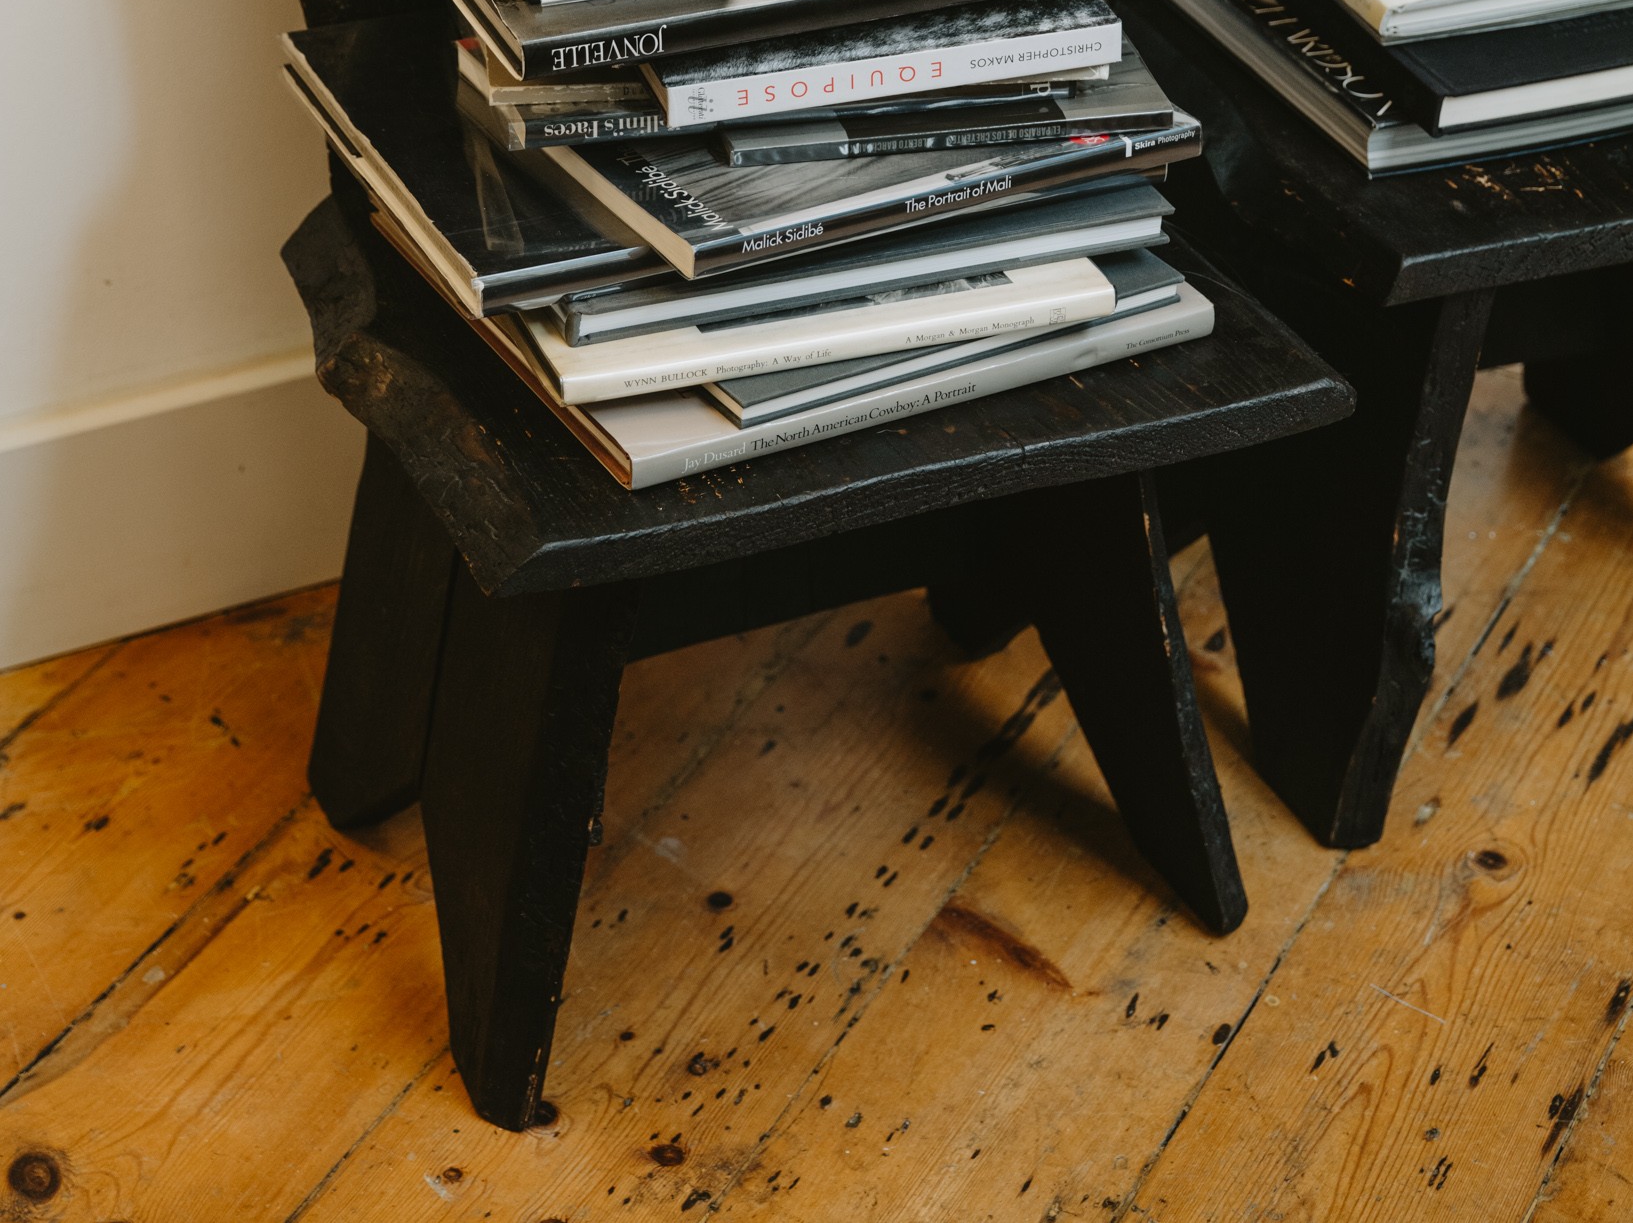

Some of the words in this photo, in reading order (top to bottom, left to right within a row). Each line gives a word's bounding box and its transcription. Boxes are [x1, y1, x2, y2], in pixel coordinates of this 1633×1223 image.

[551, 24, 668, 72] JONVELLE
[1017, 40, 1103, 63] CHRISTOPHER
[970, 54, 1015, 70] MAKOS
[737, 61, 943, 107] EQUIPOSE
[544, 118, 599, 140] Faces
[990, 130, 1007, 141] LOS
[1007, 129, 1018, 140] DE
[1050, 125, 1061, 136] EL
[1134, 139, 1156, 151] Skira
[1157, 130, 1197, 145] Photography
[636, 164, 689, 200] Sidibé
[674, 195, 732, 231] Malick
[742, 231, 783, 254] Malick
[784, 222, 824, 244] Sidibé
[905, 199, 926, 214] The
[928, 187, 971, 208] Portrait
[972, 185, 985, 197] of
[986, 176, 1012, 195] Mali
[905, 336, 912, 344] A
[915, 332, 945, 345] Morgan
[948, 329, 955, 337] &
[959, 325, 989, 338] Morgan
[991, 316, 1036, 332] Monograph
[1126, 341, 1139, 351] The
[1138, 332, 1174, 348] Consortium
[1174, 328, 1190, 338] Press
[623, 376, 657, 389] WYNN
[661, 368, 708, 383] BULLOCK
[716, 359, 768, 375] Photography:
[772, 357, 779, 366] A
[783, 353, 802, 366] Way
[805, 351, 814, 361] of
[816, 348, 832, 359] Life
[681, 457, 702, 474] Jay
[703, 442, 747, 465] Dusard
[750, 436, 775, 452] The
[775, 426, 810, 447] North
[811, 413, 868, 437] American
[869, 399, 921, 421] Cowboy:
[921, 394, 931, 406] A
[933, 382, 977, 403] Portrait
